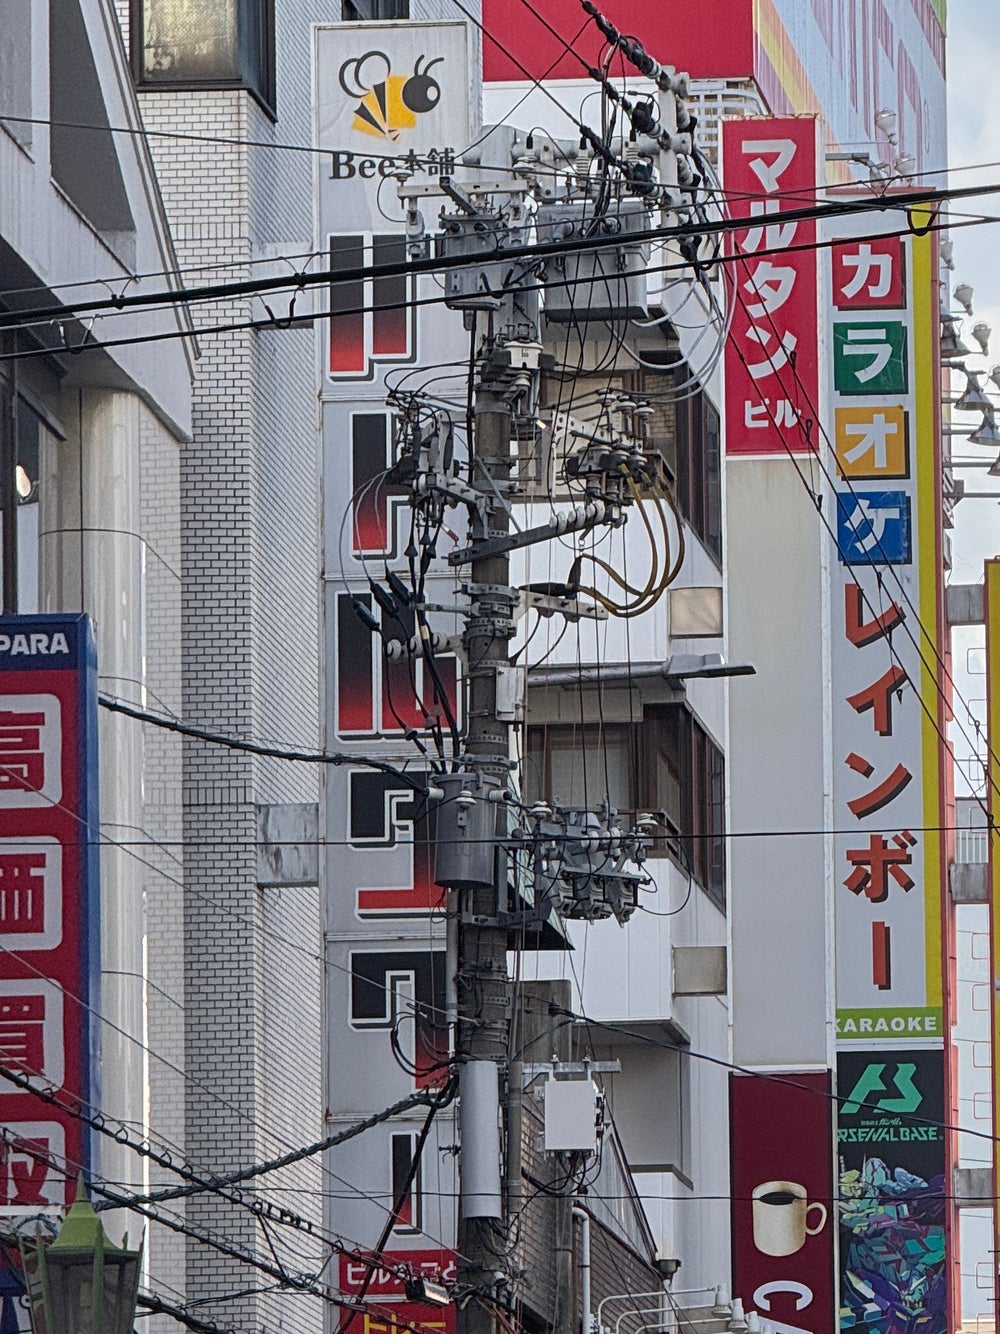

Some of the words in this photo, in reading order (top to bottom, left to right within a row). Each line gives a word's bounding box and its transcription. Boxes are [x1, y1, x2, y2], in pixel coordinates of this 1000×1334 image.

[741, 139, 798, 381] マルタン
[744, 397, 801, 429] ビル
[842, 244, 902, 553] カラオケ
[844, 583, 918, 990] レインボー
[836, 1127, 898, 1142] RSENAL
